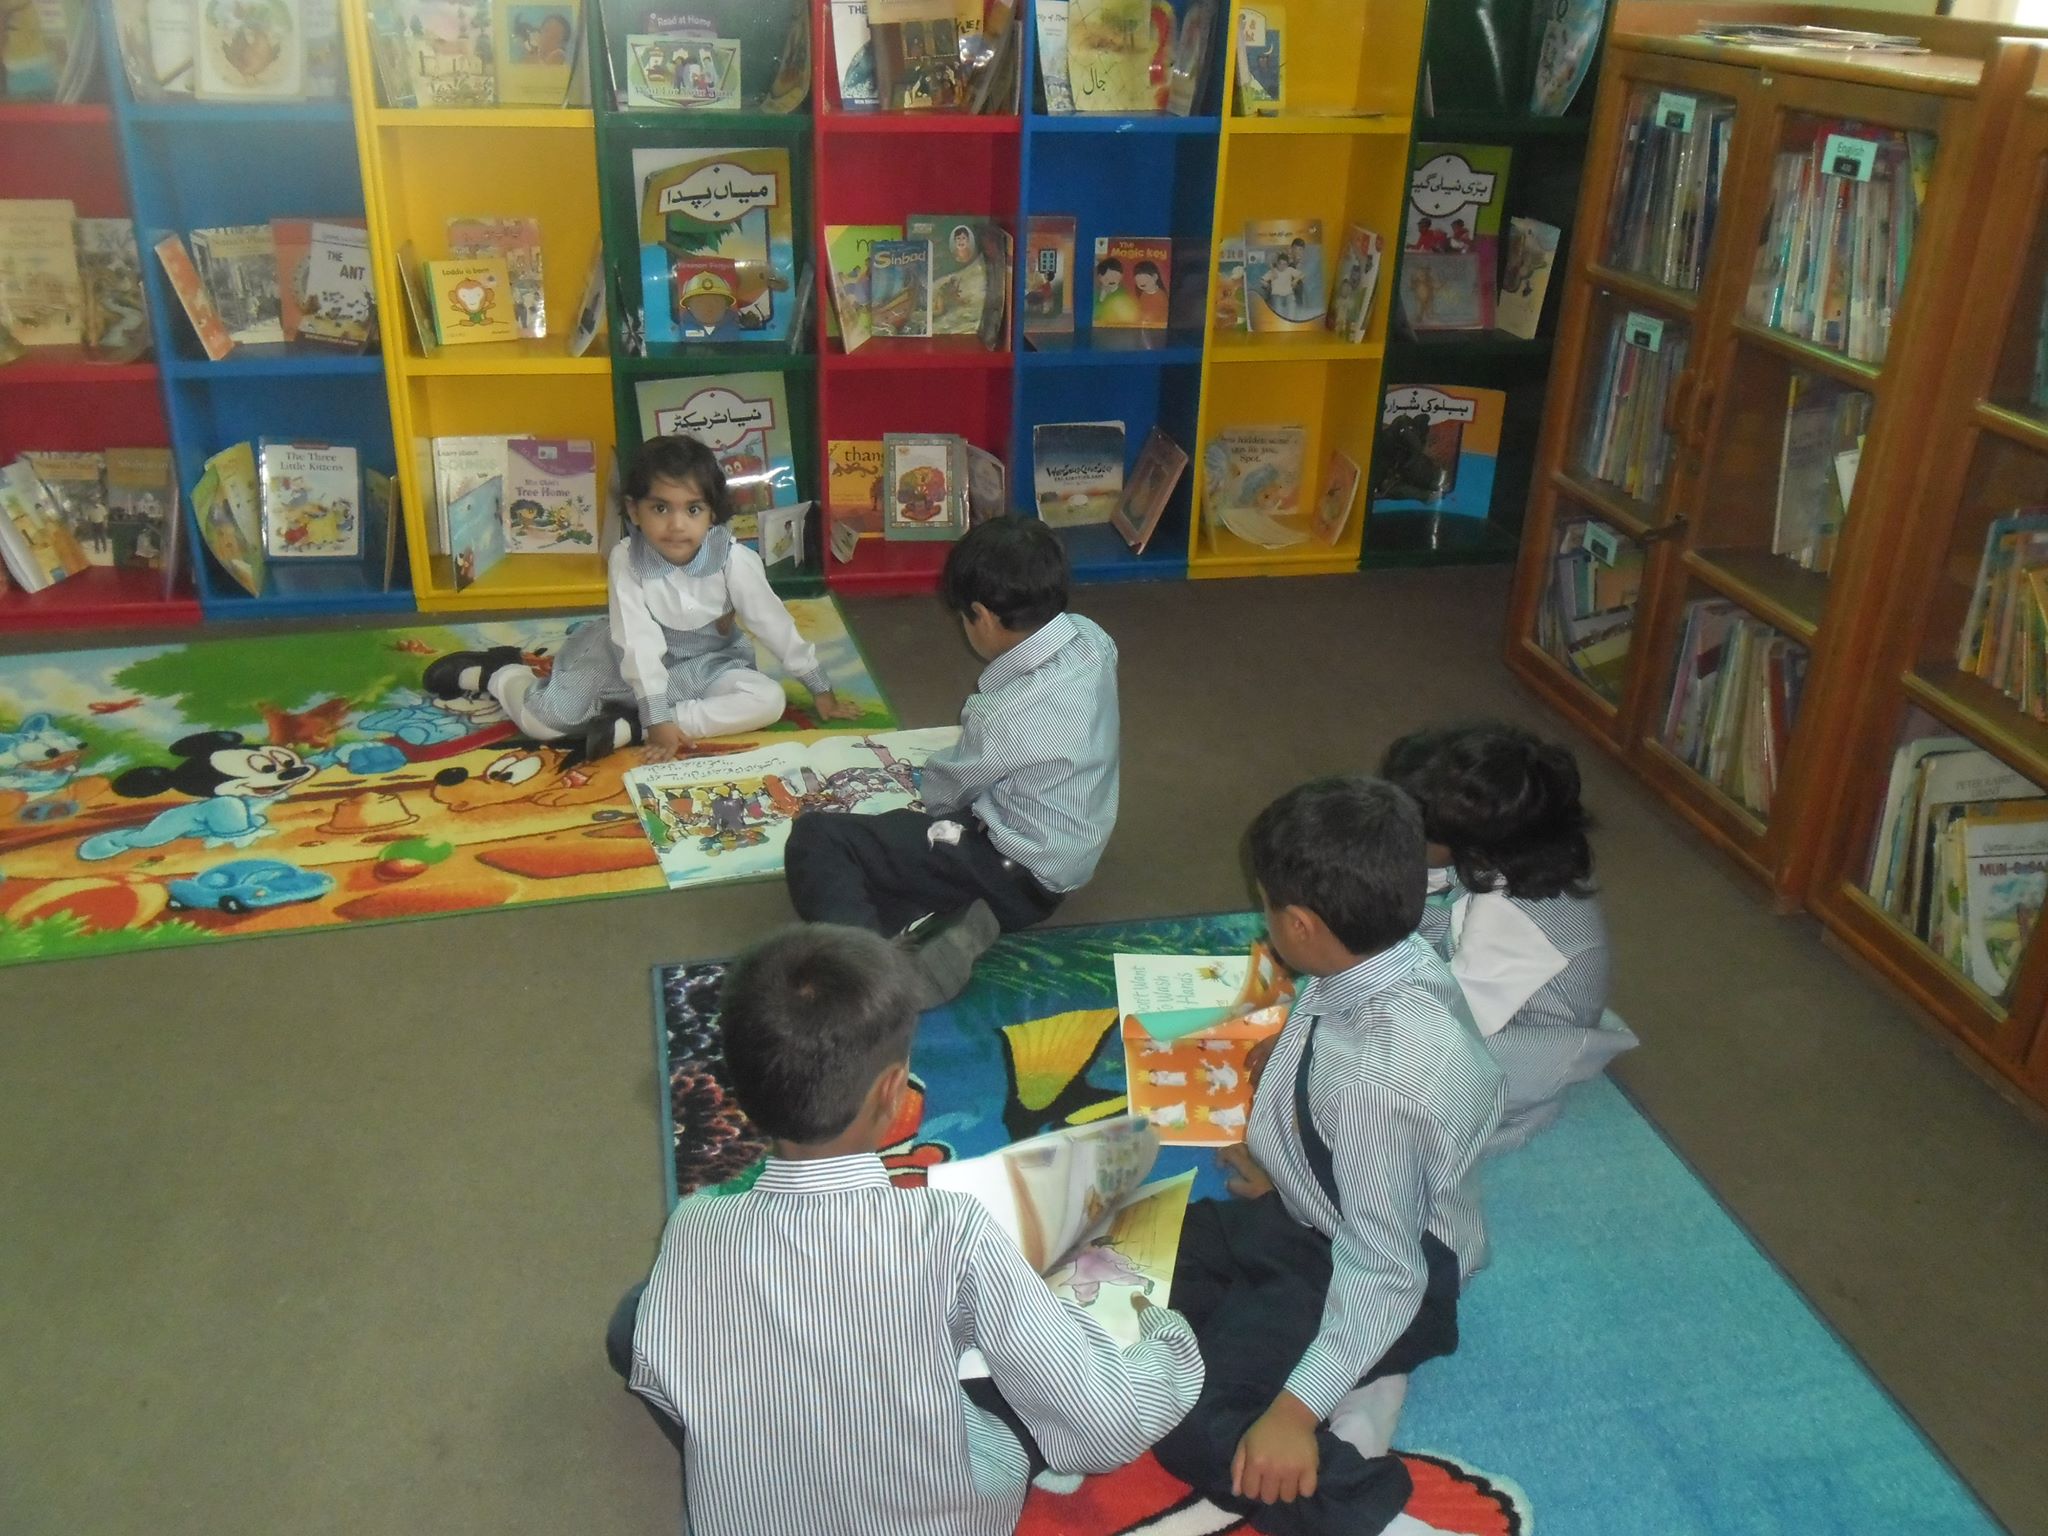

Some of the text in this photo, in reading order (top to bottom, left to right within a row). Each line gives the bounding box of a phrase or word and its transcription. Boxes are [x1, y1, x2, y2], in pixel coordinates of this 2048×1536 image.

[848, 5, 867, 15] THE
[1082, 65, 1106, 95] جال
[1119, 241, 1135, 249] The
[327, 250, 343, 262] THE
[1111, 248, 1144, 258] Magic
[873, 250, 927, 268] Sinbad
[340, 264, 366, 281] ANT
[286, 452, 337, 462] The Three
[280, 461, 344, 472] Little Kittens
[515, 485, 571, 498] Tree Home
